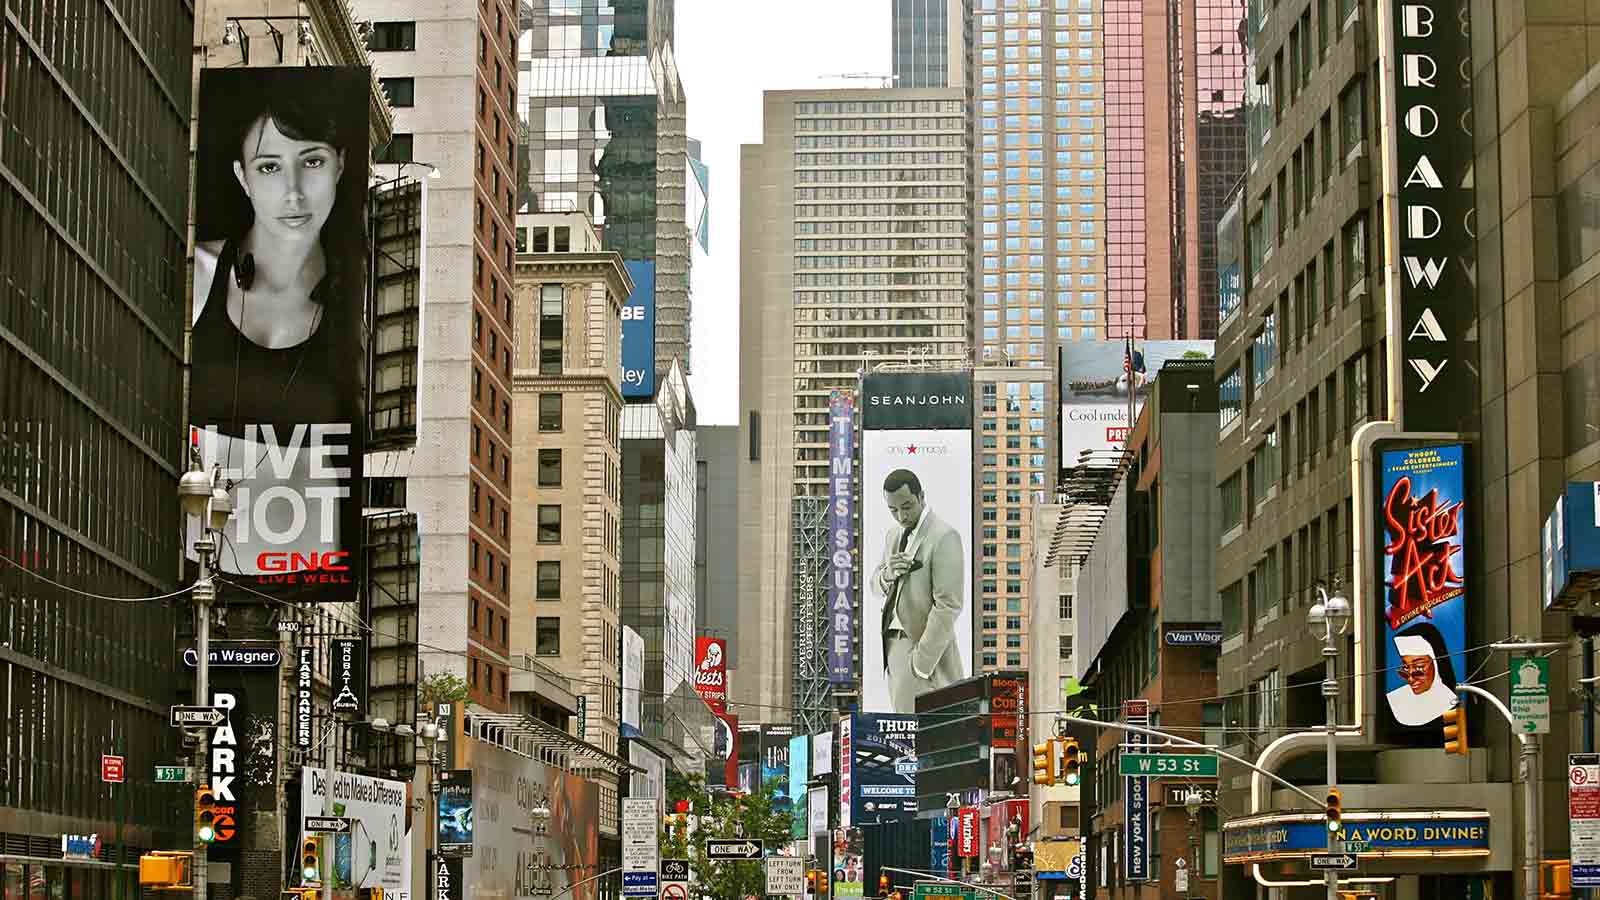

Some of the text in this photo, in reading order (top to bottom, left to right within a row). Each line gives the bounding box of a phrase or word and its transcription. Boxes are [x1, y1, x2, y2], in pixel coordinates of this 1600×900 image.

[1401, 4, 1448, 393] BROADWAY
[1069, 409, 1127, 422] Cool unde
[204, 423, 351, 479] LIVE
[1384, 476, 1464, 554] Sister
[832, 416, 852, 653] TIMES SQUARE
[256, 552, 350, 572] GNC
[1394, 537, 1465, 612] Act
[257, 574, 350, 584] LIVE WELL
[799, 557, 807, 679] AMERICAN EAGLE
[806, 575, 814, 660] OUTFITTERS
[1171, 632, 1193, 641] Van
[221, 649, 276, 664] Wagner
[341, 647, 351, 692] ROBATA
[299, 649, 311, 746] FLASH DANCERS
[704, 691, 725, 701] STRIPS
[181, 713, 220, 721] ONE WAY
[212, 692, 237, 802] PARK
[157, 769, 163, 779] W
[166, 768, 175, 780] 53
[1139, 759, 1200, 771] W 53 St
[351, 778, 368, 802] Make
[373, 780, 402, 807] Difference
[863, 786, 904, 795] WELCOME
[213, 806, 235, 814] con
[962, 812, 974, 853] Twizzlers
[1131, 812, 1143, 842] york
[1351, 829, 1363, 841] A
[1424, 827, 1484, 840] DIVINE!
[715, 845, 754, 853] ONE WAY
[1133, 846, 1141, 874] new
